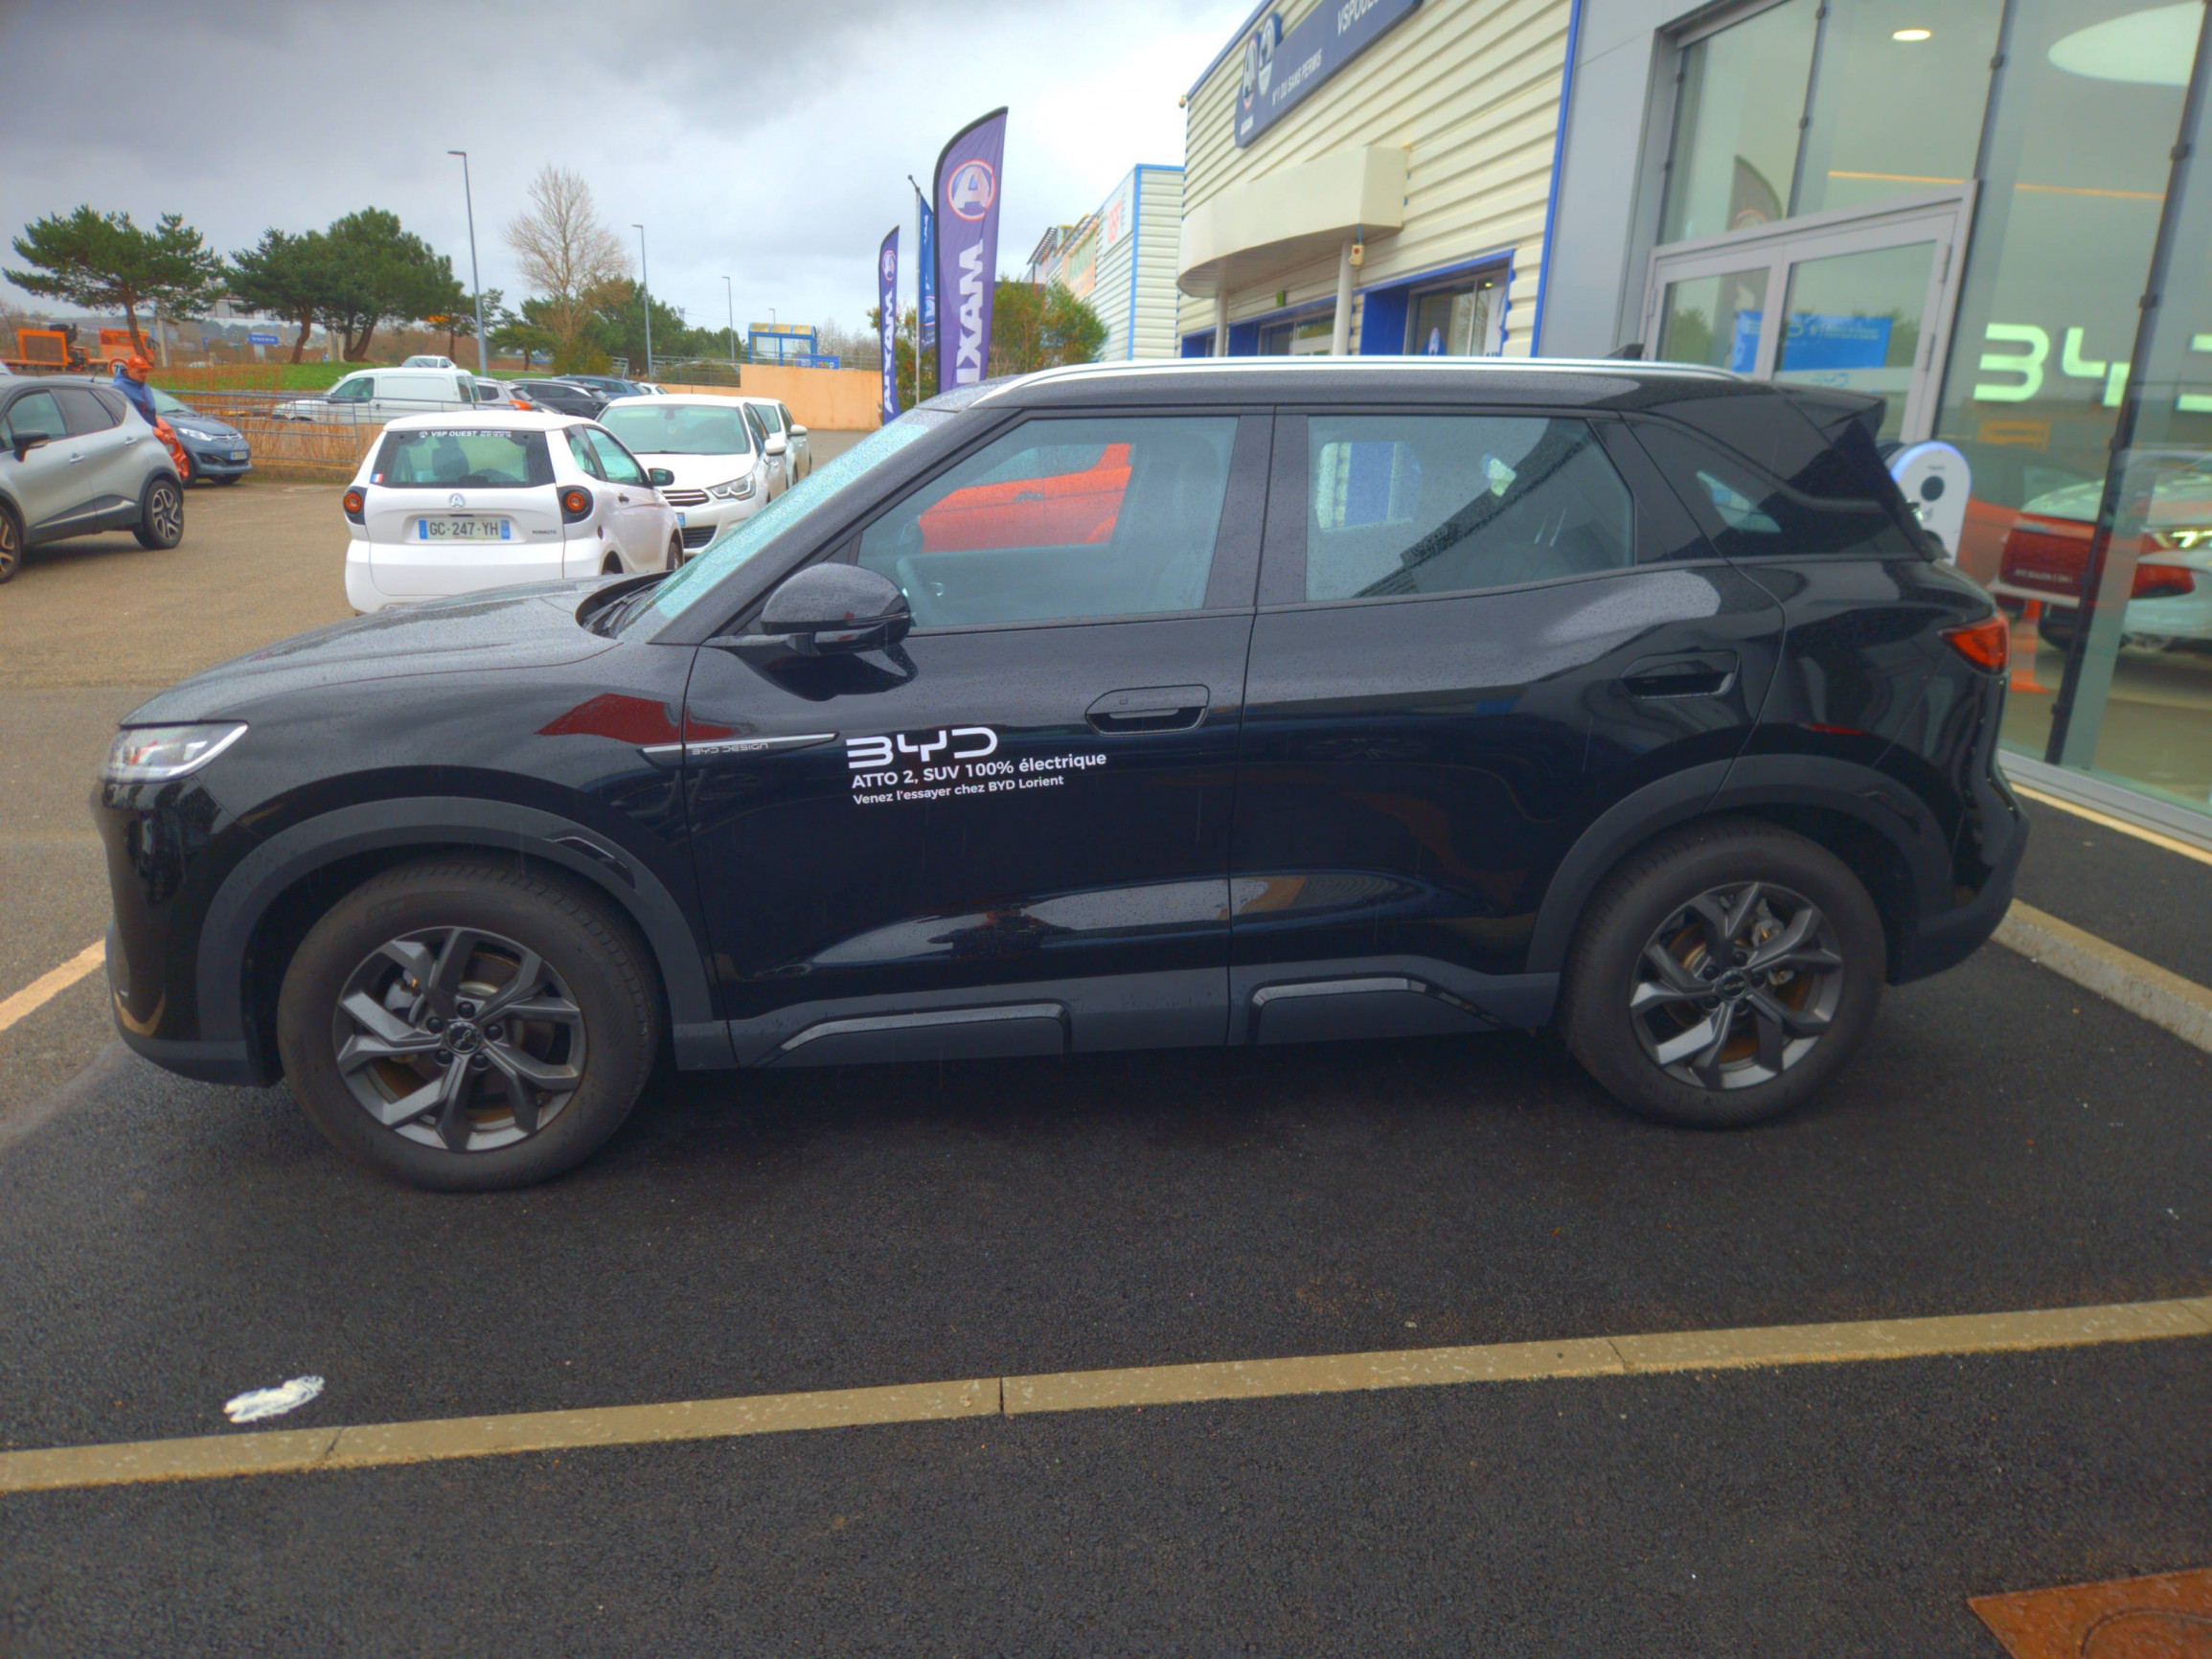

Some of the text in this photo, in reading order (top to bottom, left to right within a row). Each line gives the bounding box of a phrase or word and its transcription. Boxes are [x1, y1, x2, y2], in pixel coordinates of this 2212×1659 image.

[1337, 0, 1379, 36] VSPOU
[1302, 48, 1322, 80] PERMIS
[956, 238, 984, 384] IXAM
[883, 287, 894, 415] AIXAM
[692, 742, 768, 756] BYD DESIGN
[846, 726, 998, 769] BYD
[851, 752, 1107, 789] ATTO 2, SUV 100% électrique
[853, 792, 894, 805] Venez
[954, 783, 986, 796] chez
[989, 780, 1015, 793] BYD
[1018, 775, 1065, 790] Lorient
